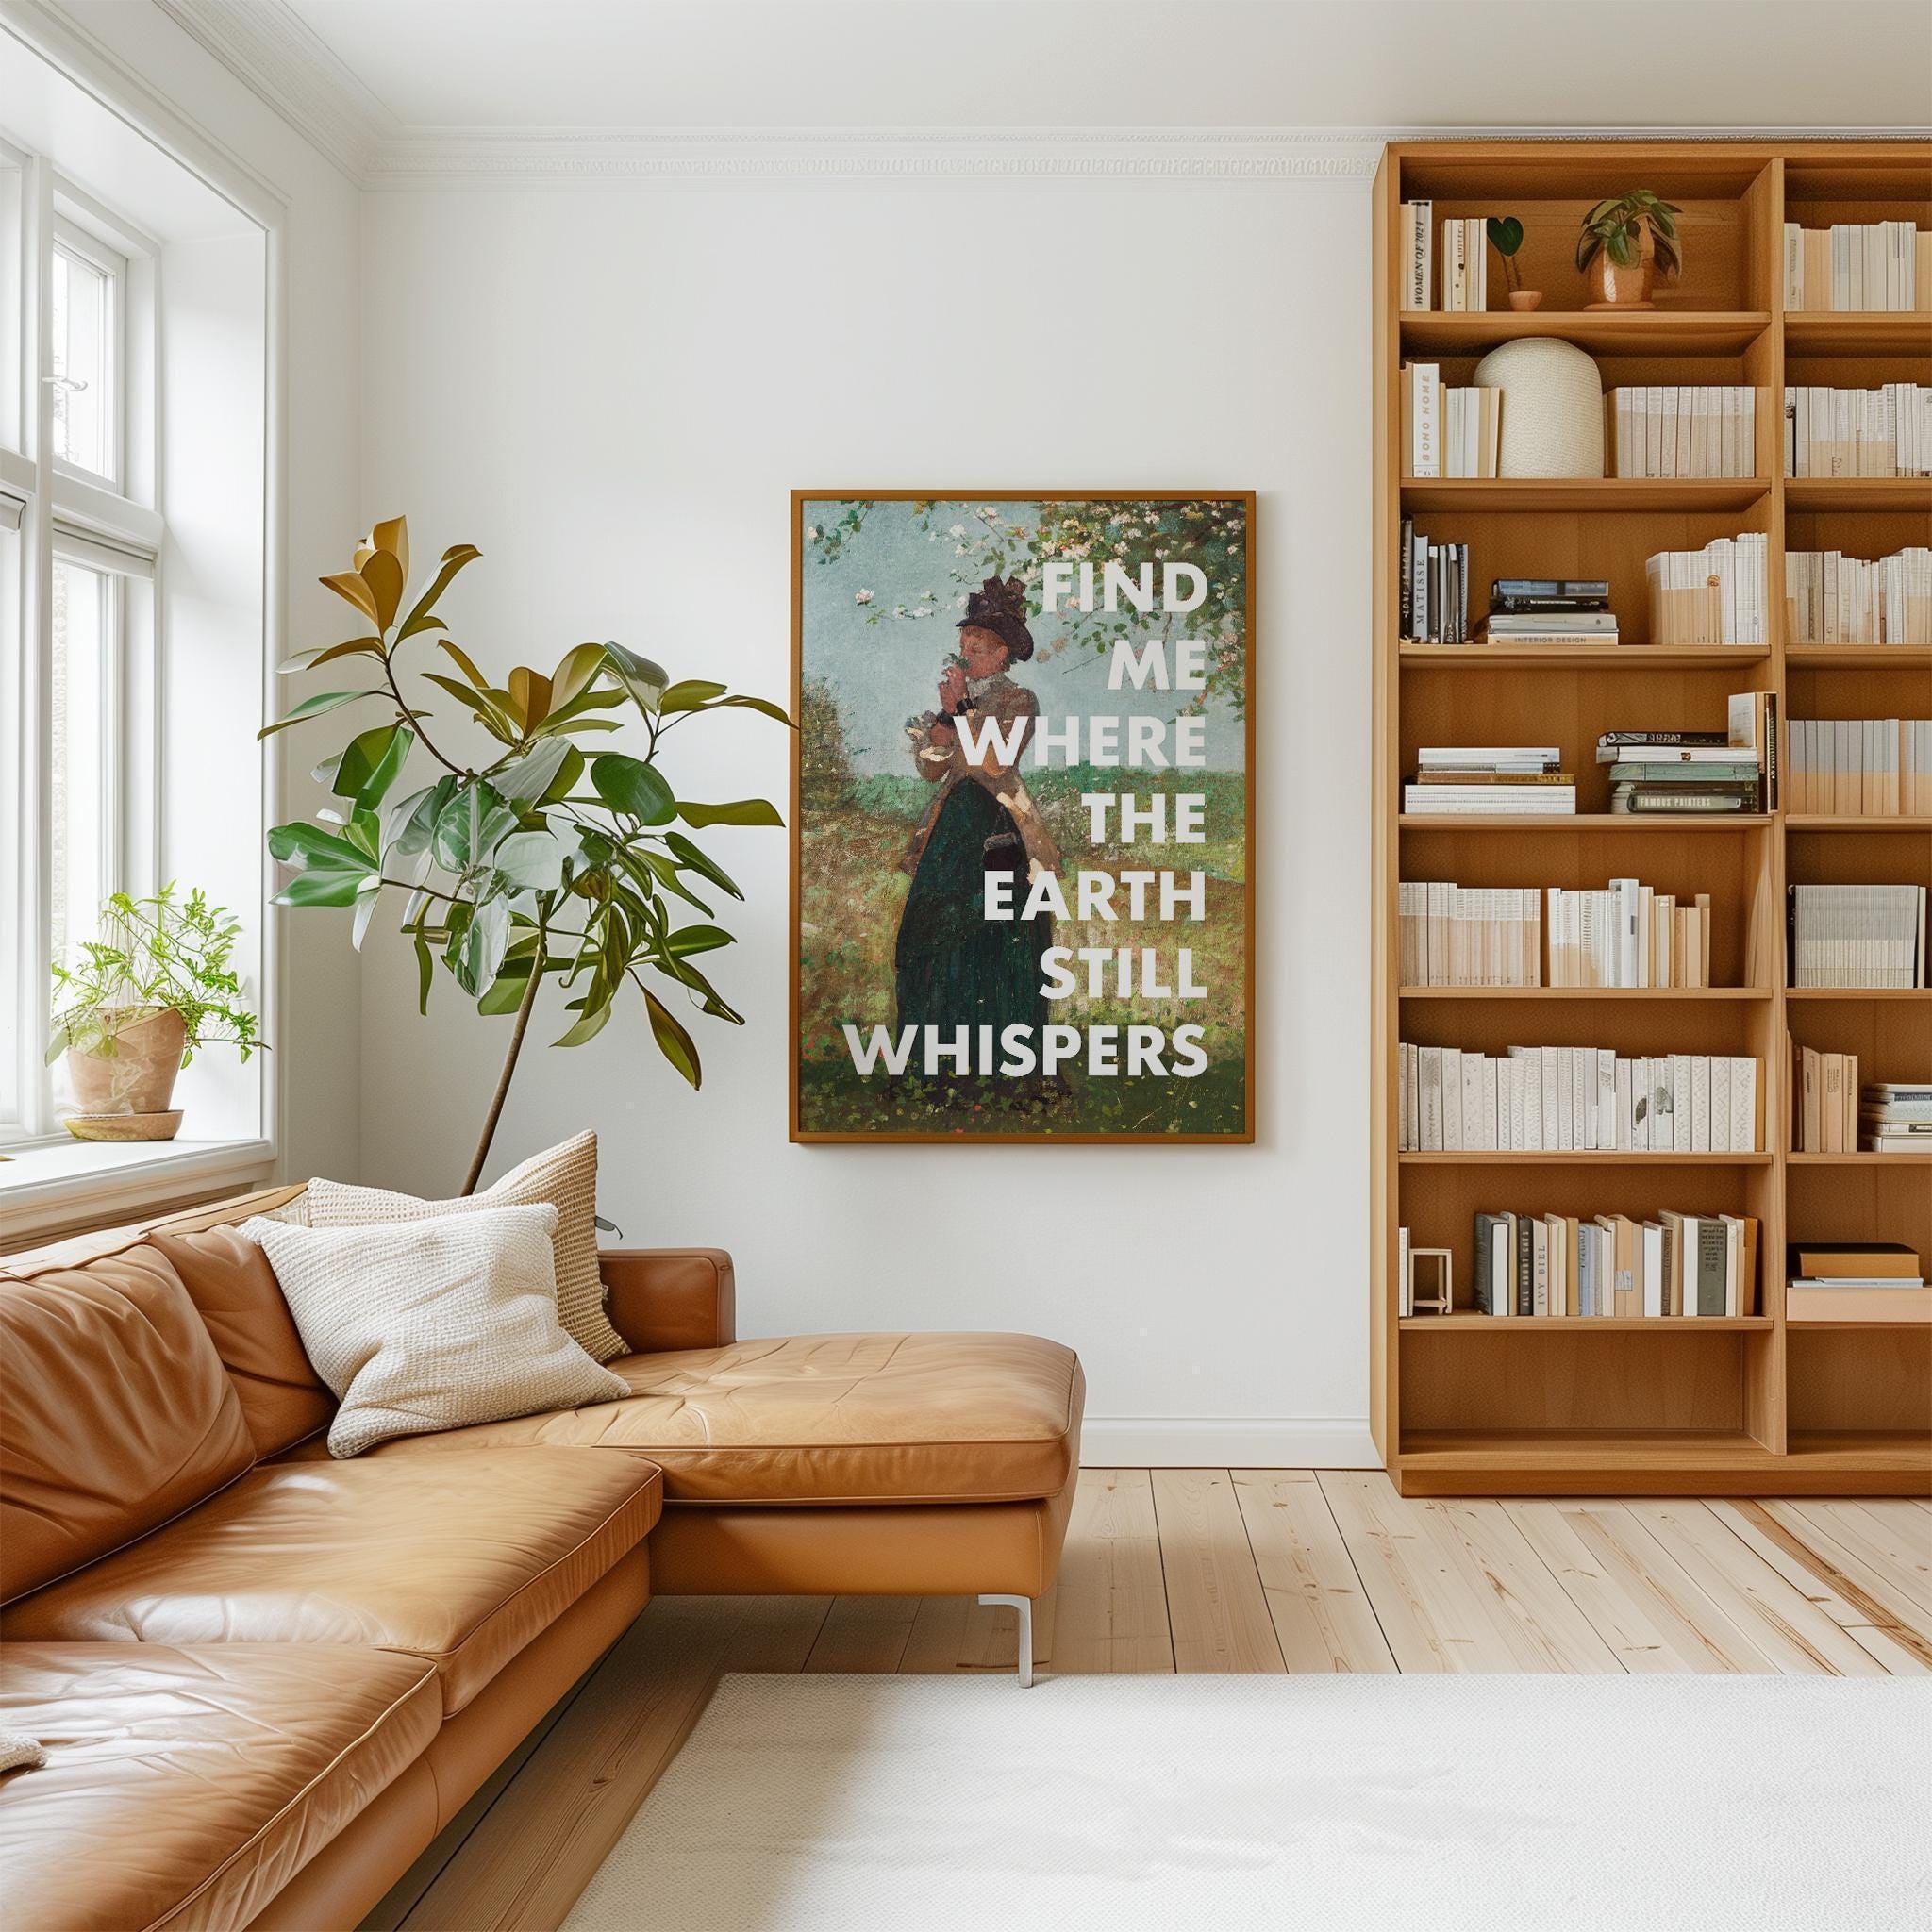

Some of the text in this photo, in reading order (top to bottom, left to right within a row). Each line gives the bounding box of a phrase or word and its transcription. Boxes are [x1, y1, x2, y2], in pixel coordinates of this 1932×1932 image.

[1415, 245, 1424, 260] OF
[1414, 261, 1424, 305] WOMEN
[1422, 375, 1430, 461] BOHO HOME
[1041, 562, 1208, 612] FIND
[1416, 559, 1425, 625] MATISSE
[1108, 640, 1206, 690] ME
[955, 716, 1206, 766] WHERE
[1081, 793, 1206, 843] THE
[1640, 797, 1711, 807] FAMOUS PAINTERS
[984, 871, 1206, 921] EARTH
[1040, 946, 1208, 999] STILL
[842, 1023, 1208, 1077] WHISPERS
[1538, 1245, 1546, 1306] IVY BIEL
